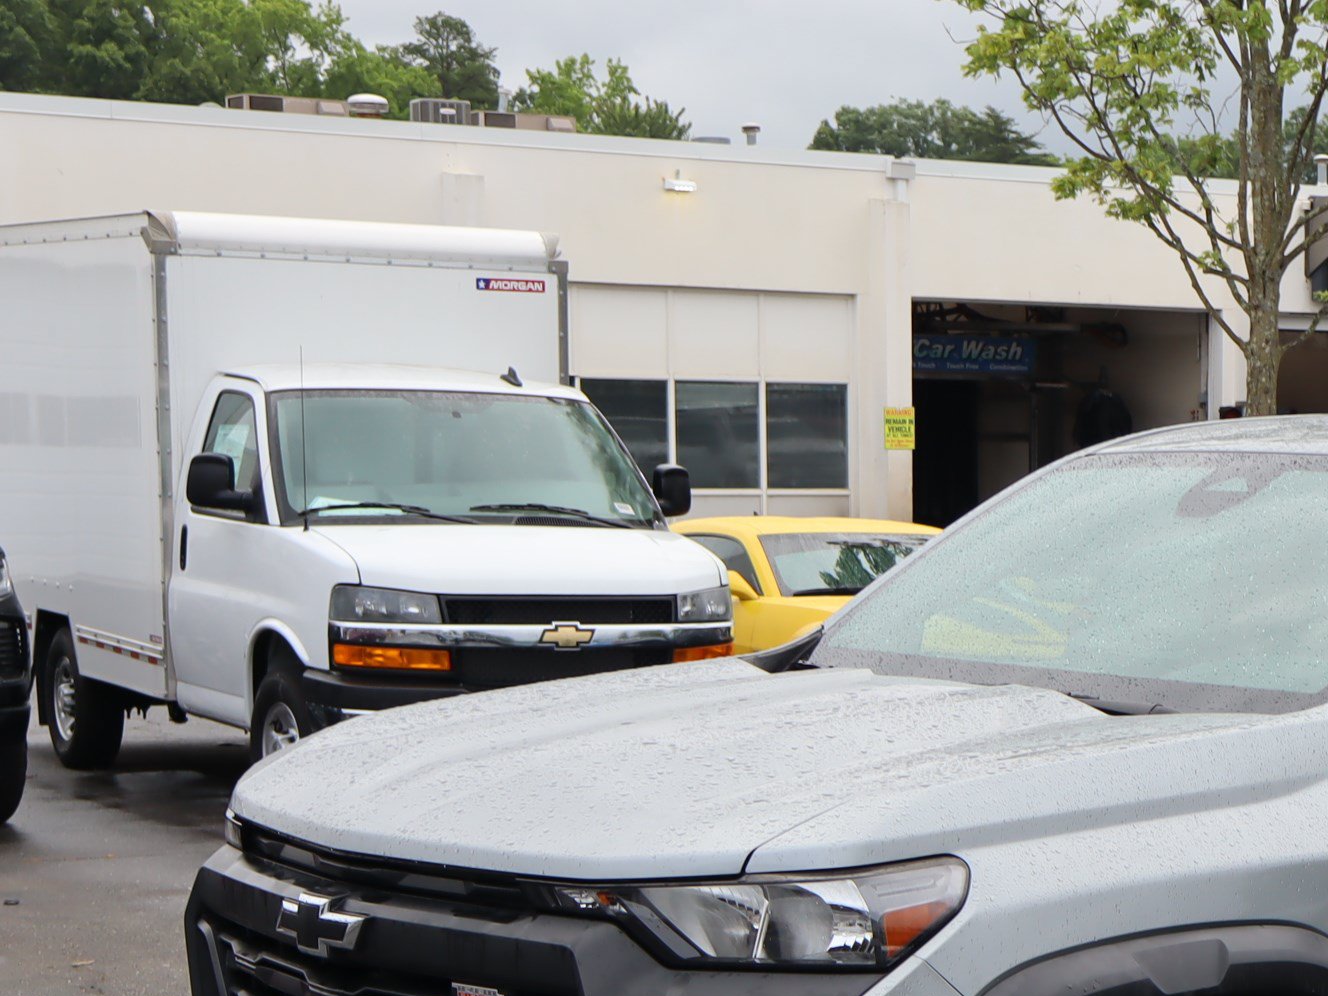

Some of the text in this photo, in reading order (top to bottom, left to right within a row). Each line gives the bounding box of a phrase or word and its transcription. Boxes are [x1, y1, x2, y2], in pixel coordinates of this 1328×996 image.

[489, 280, 543, 291] MORGAN
[914, 338, 1023, 361] Car Wash
